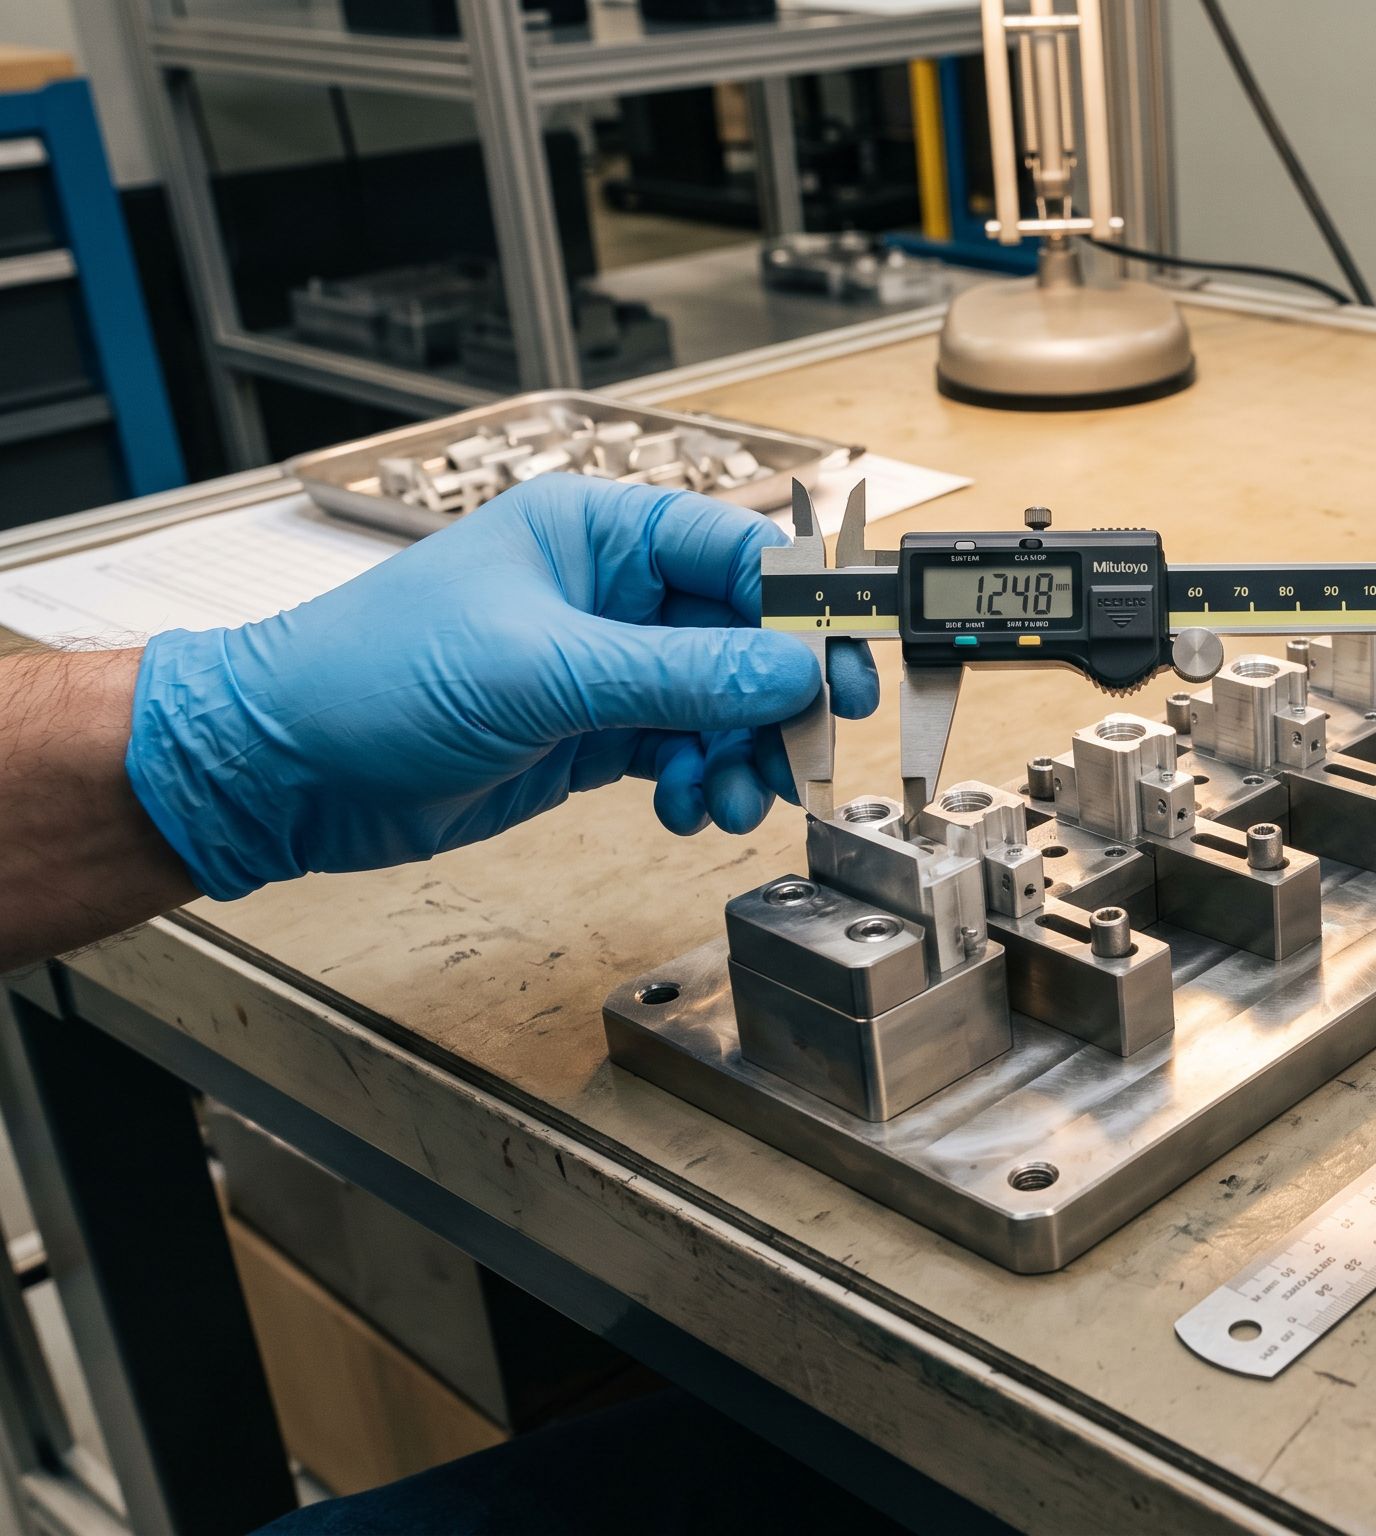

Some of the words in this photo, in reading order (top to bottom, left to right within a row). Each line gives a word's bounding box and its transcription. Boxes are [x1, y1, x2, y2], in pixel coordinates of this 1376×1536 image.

[1093, 561, 1148, 575] Mitutoyo
[815, 591, 824, 601] 0
[856, 591, 871, 601] 10
[1187, 586, 1203, 598] 60
[1233, 586, 1249, 598] 70
[1279, 586, 1294, 597] 80
[1324, 585, 1339, 597] 90
